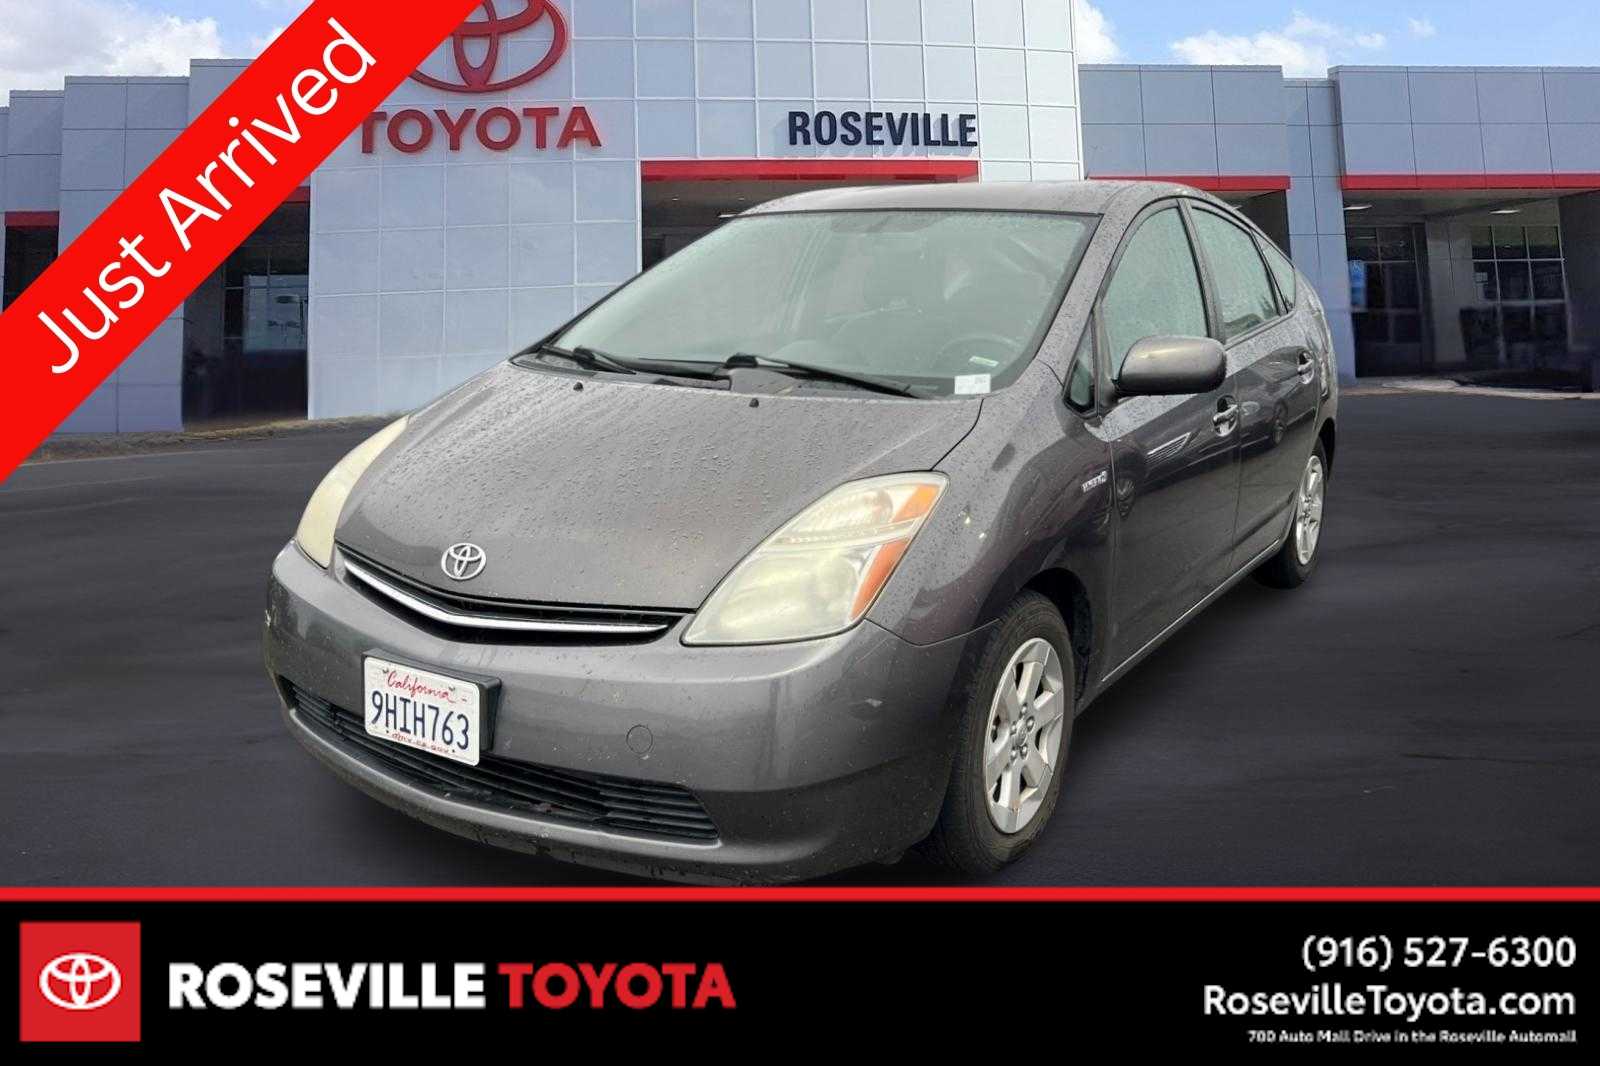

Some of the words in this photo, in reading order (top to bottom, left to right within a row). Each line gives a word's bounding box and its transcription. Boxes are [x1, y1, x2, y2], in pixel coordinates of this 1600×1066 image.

[362, 106, 602, 154] TOYOTA
[788, 110, 978, 147] ROSEVILLE
[387, 670, 457, 704] California
[371, 690, 469, 751] 9HIH763
